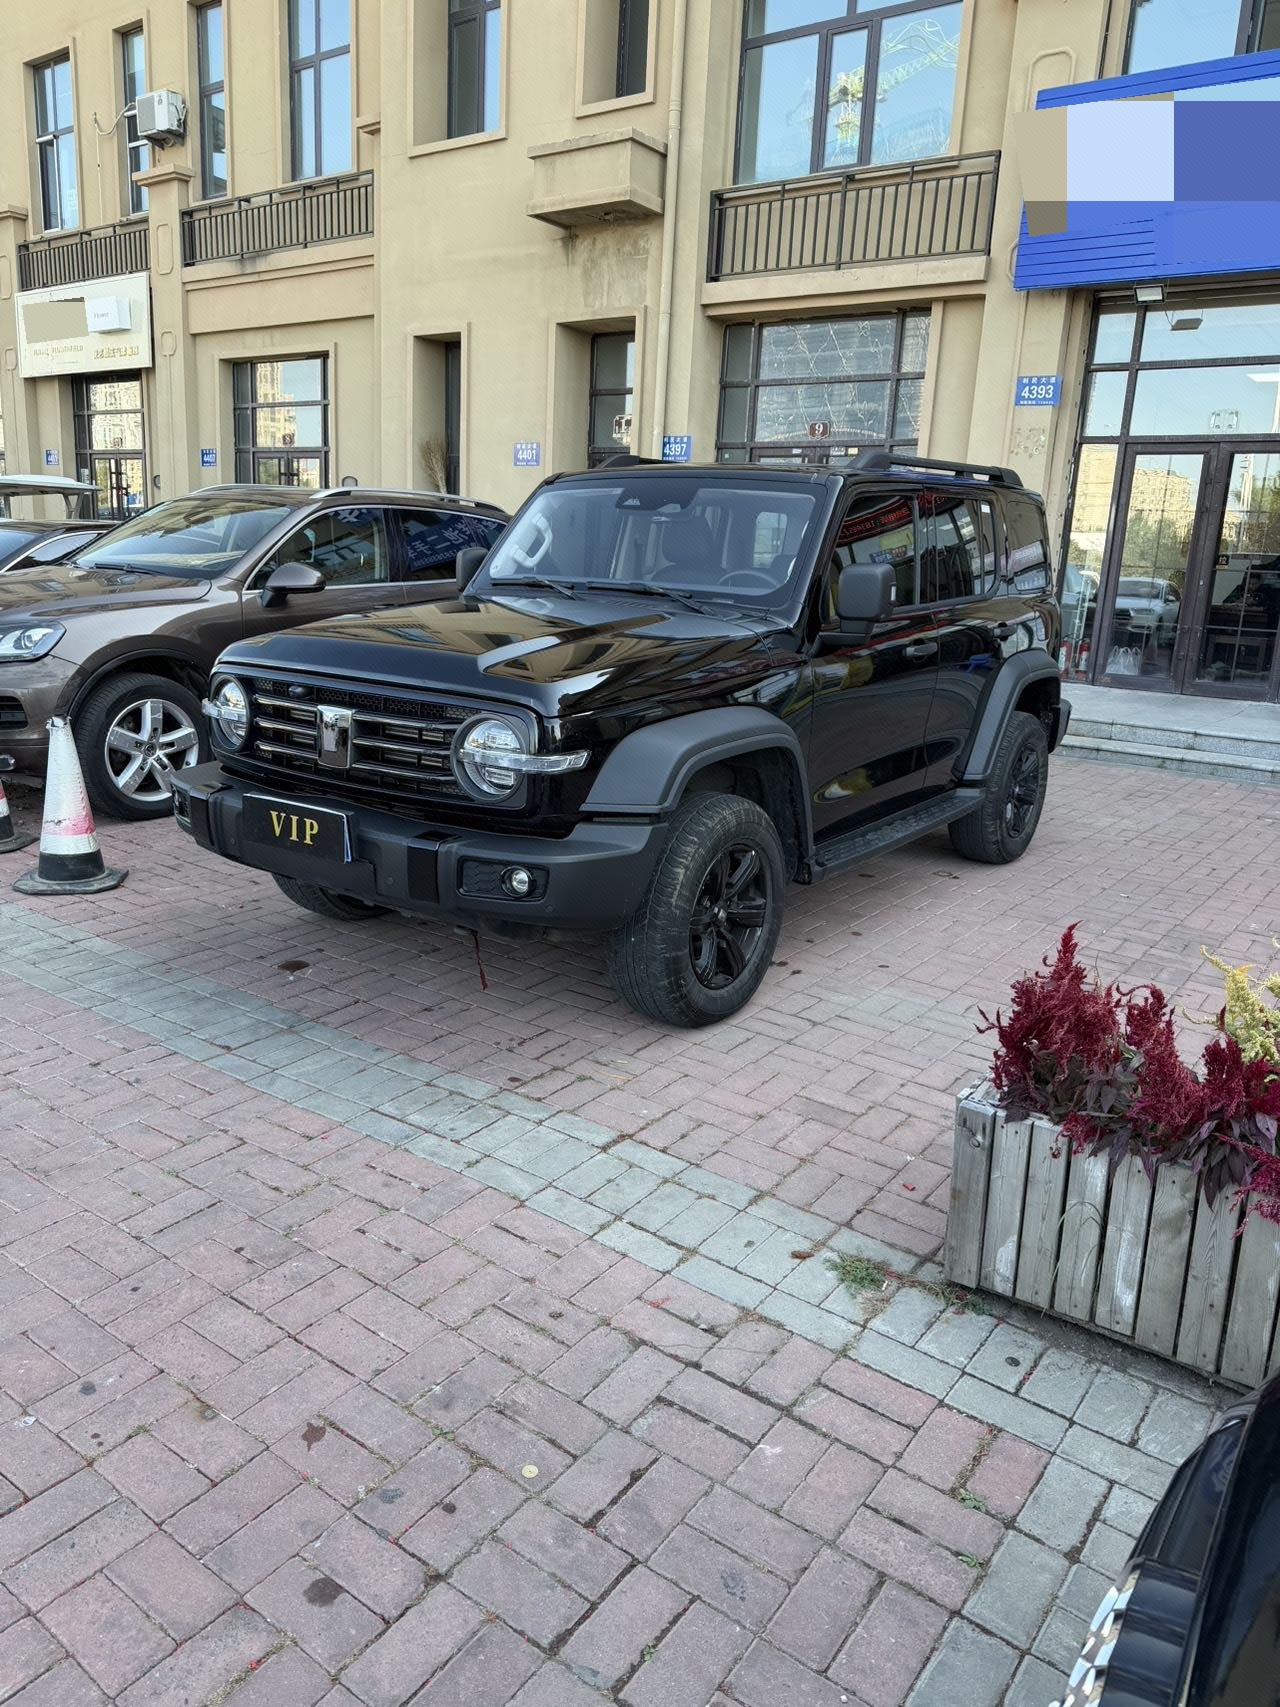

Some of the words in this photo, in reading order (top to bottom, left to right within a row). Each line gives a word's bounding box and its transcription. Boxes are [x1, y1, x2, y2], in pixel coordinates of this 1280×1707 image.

[1021, 385, 1054, 399] 4393
[815, 423, 824, 434] 9
[517, 449, 536, 460] 4401
[663, 443, 687, 456] 4397
[269, 810, 319, 845] VIP
